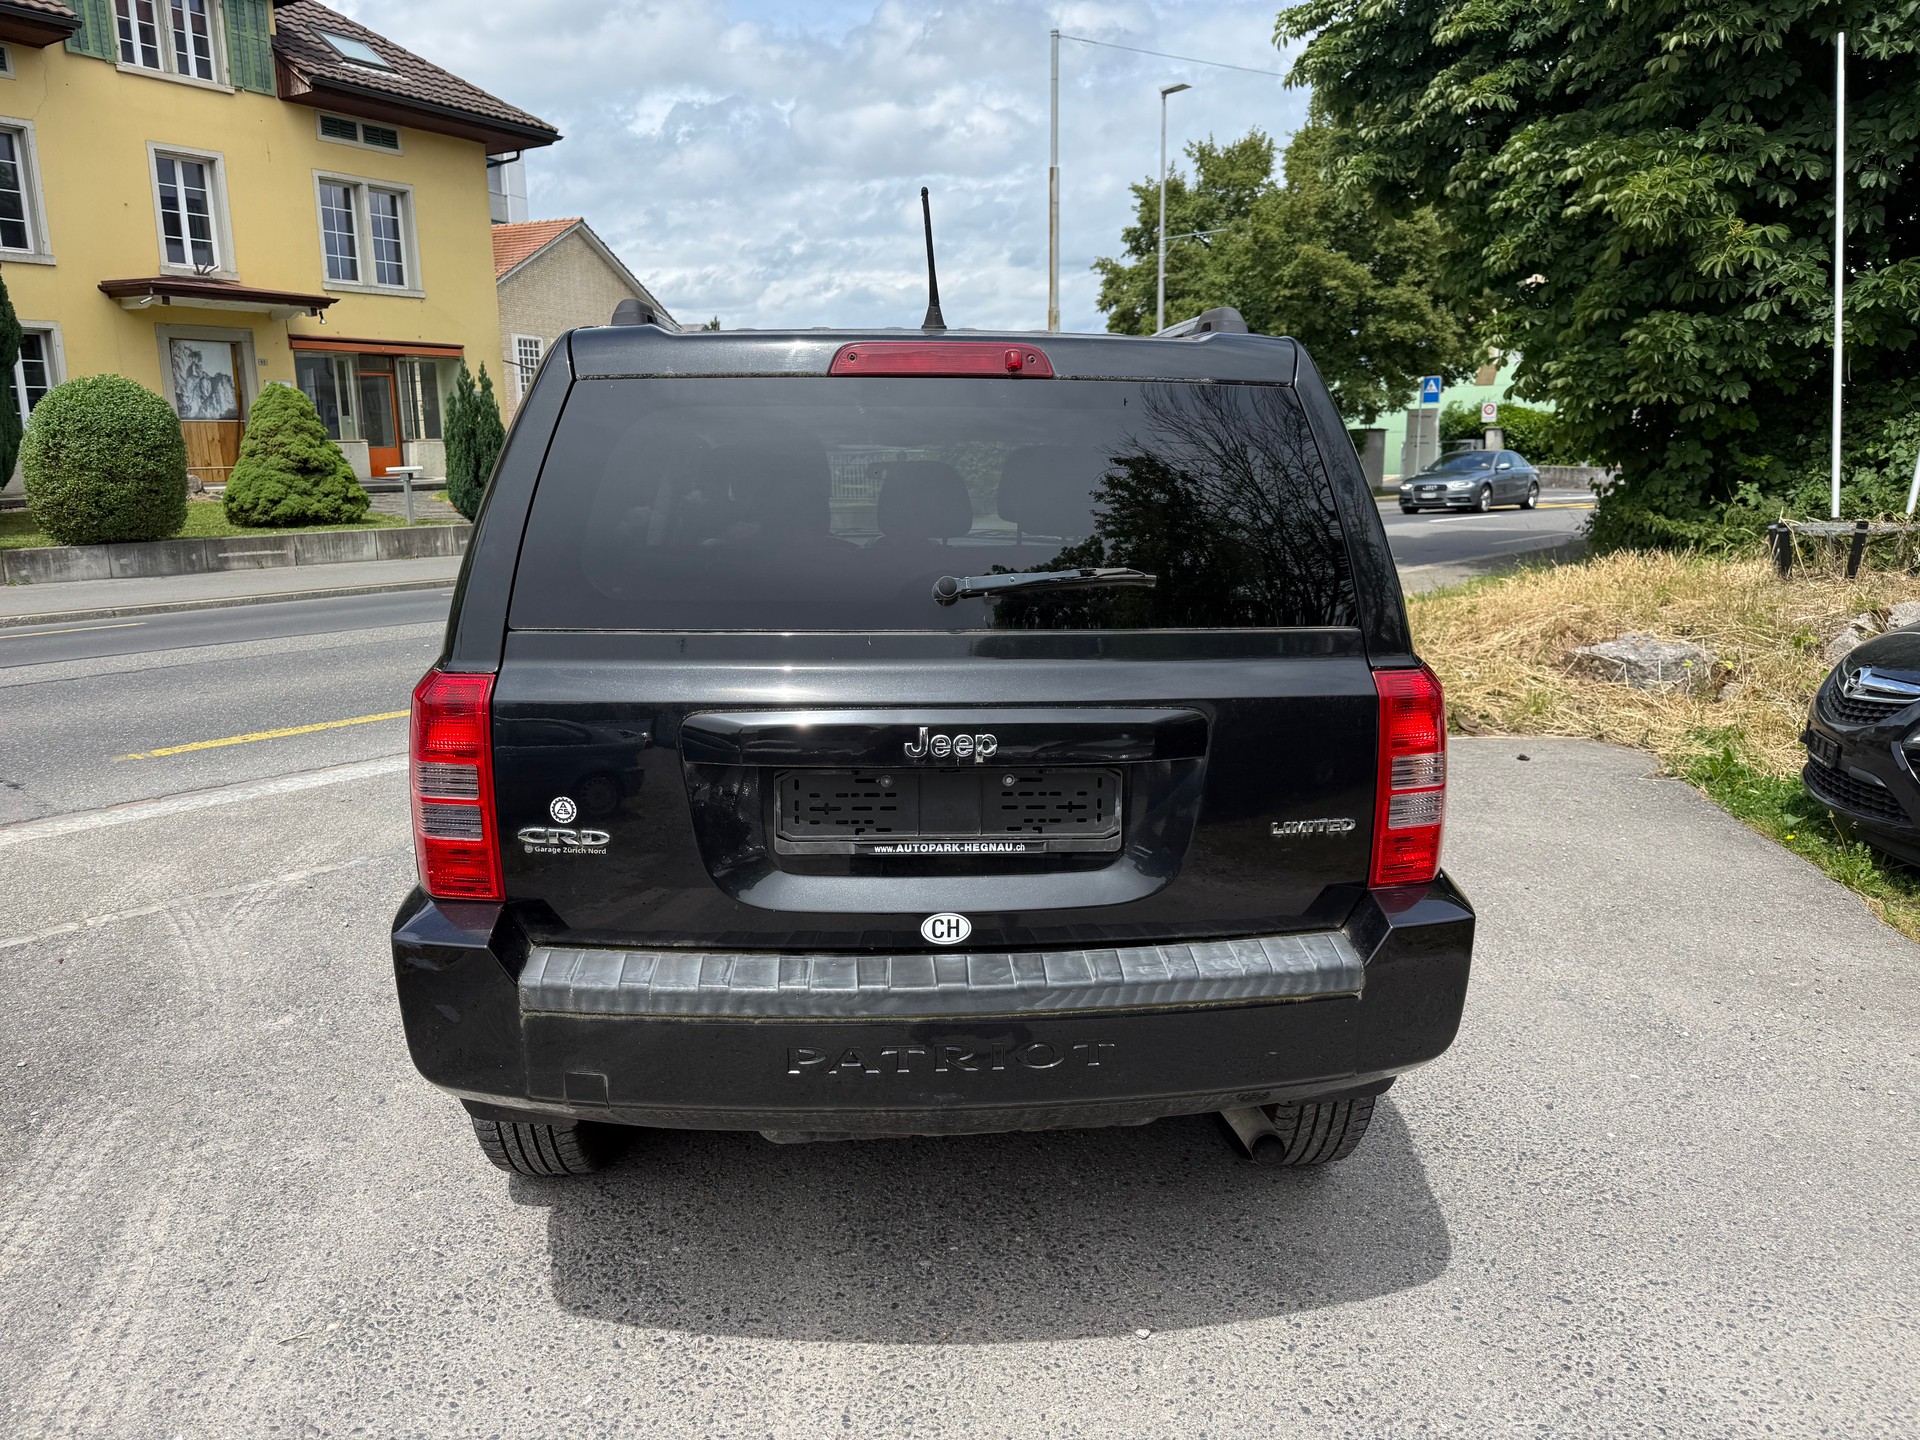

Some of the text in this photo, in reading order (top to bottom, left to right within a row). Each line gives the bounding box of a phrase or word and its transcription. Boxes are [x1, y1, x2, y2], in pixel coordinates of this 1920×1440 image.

[904, 727, 998, 763] Jeep
[1271, 817, 1356, 835] LIMITED
[518, 828, 610, 845] CRD
[534, 846, 561, 854] Garage
[563, 846, 586, 854] Zürich
[874, 842, 1025, 853] www.AUTOPARK-HEGNAU.ch
[931, 919, 960, 939] CH
[787, 1041, 1115, 1073] PATRIOT
